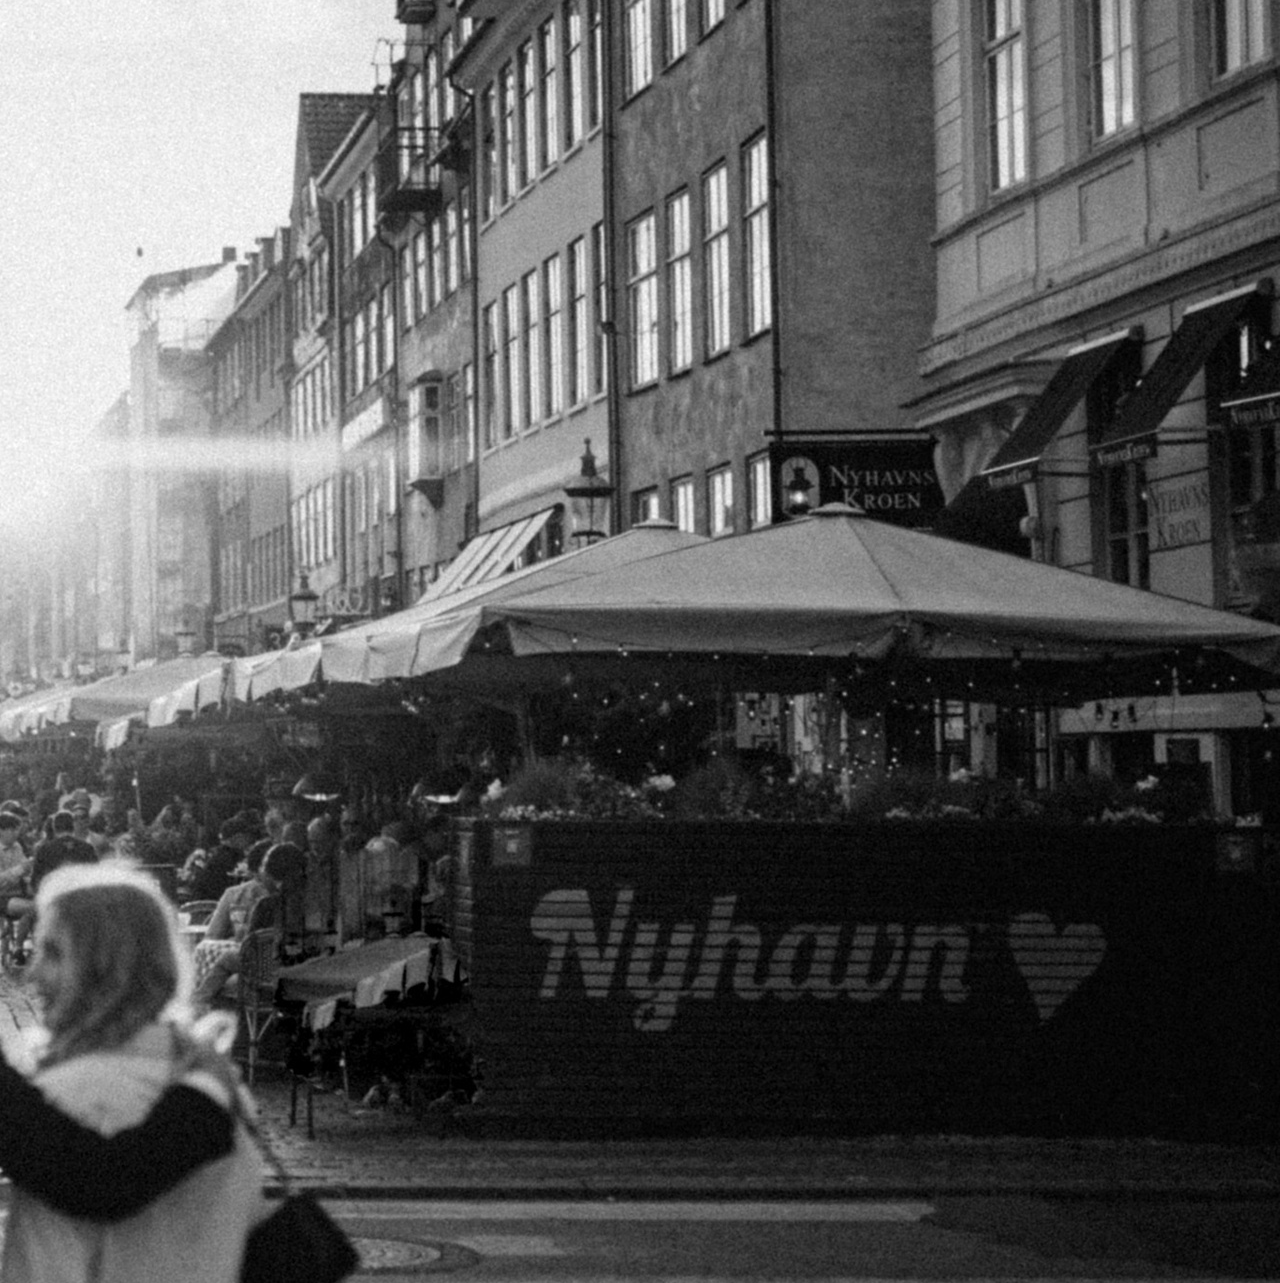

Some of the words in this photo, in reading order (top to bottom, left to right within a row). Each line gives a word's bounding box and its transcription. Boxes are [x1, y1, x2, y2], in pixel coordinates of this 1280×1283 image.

[829, 465, 934, 487] NYHAVNS
[843, 488, 921, 510] KROEN
[530, 888, 972, 1031] Nyhavn
